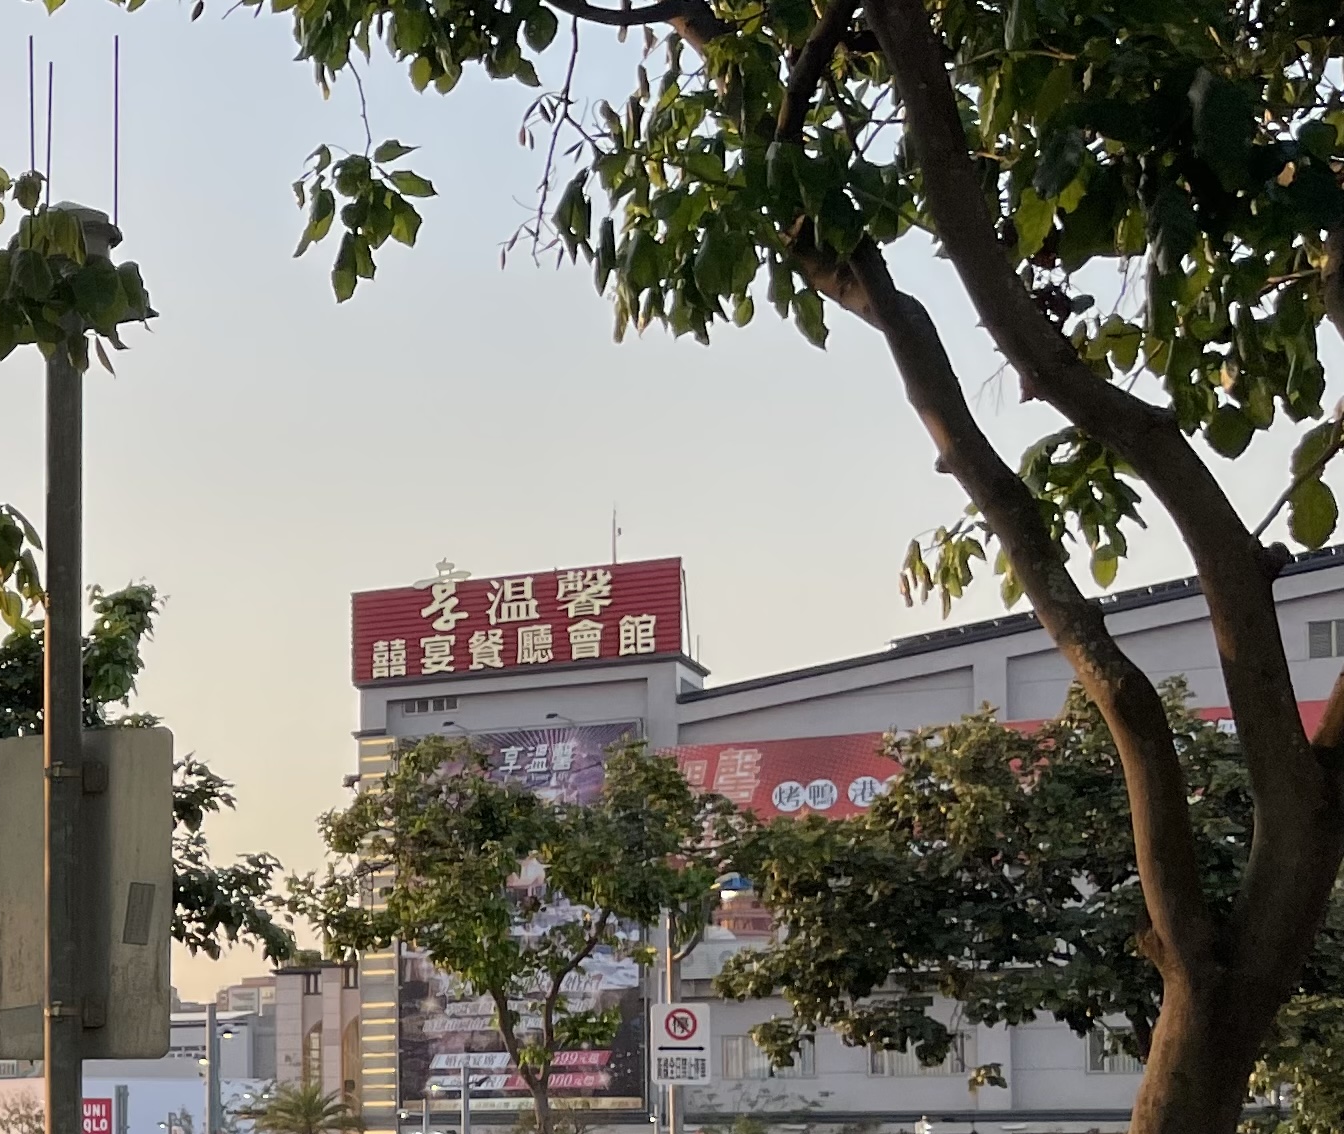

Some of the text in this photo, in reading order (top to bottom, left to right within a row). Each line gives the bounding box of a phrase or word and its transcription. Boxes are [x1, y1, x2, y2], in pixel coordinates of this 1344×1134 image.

[372, 614, 657, 679] 囍宴餐廳會館
[774, 782, 835, 808] 烤鴨
[83, 1104, 106, 1116] UNI
[83, 1118, 108, 1132] QLO
